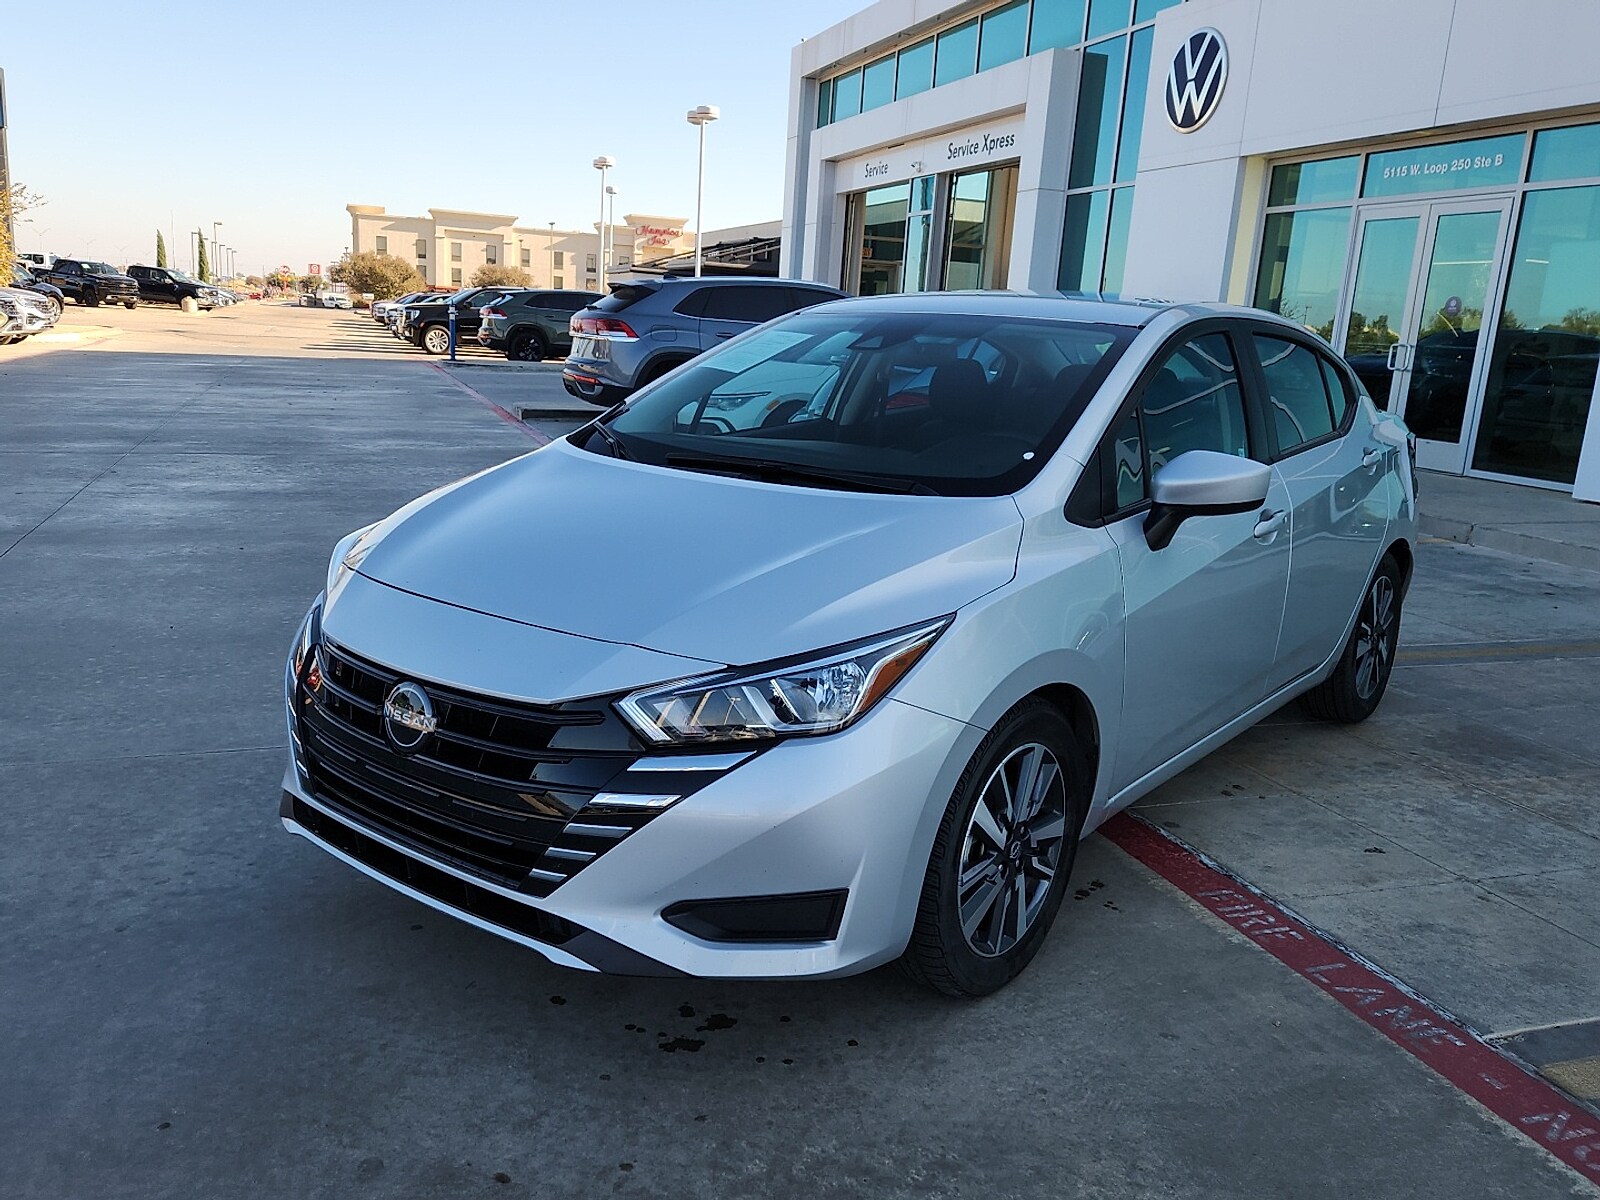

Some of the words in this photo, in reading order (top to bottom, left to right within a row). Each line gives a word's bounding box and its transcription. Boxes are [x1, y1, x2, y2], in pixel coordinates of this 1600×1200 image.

[947, 139, 979, 160] Service
[981, 133, 1015, 155] Xpress
[864, 161, 889, 178] Service
[1383, 165, 1408, 178] 5115
[1410, 164, 1421, 175] W.
[1424, 162, 1448, 175] Loop
[1450, 158, 1471, 171] 250
[1474, 156, 1491, 168] Ste
[1494, 154, 1504, 166] B
[384, 702, 437, 732] NISSAN
